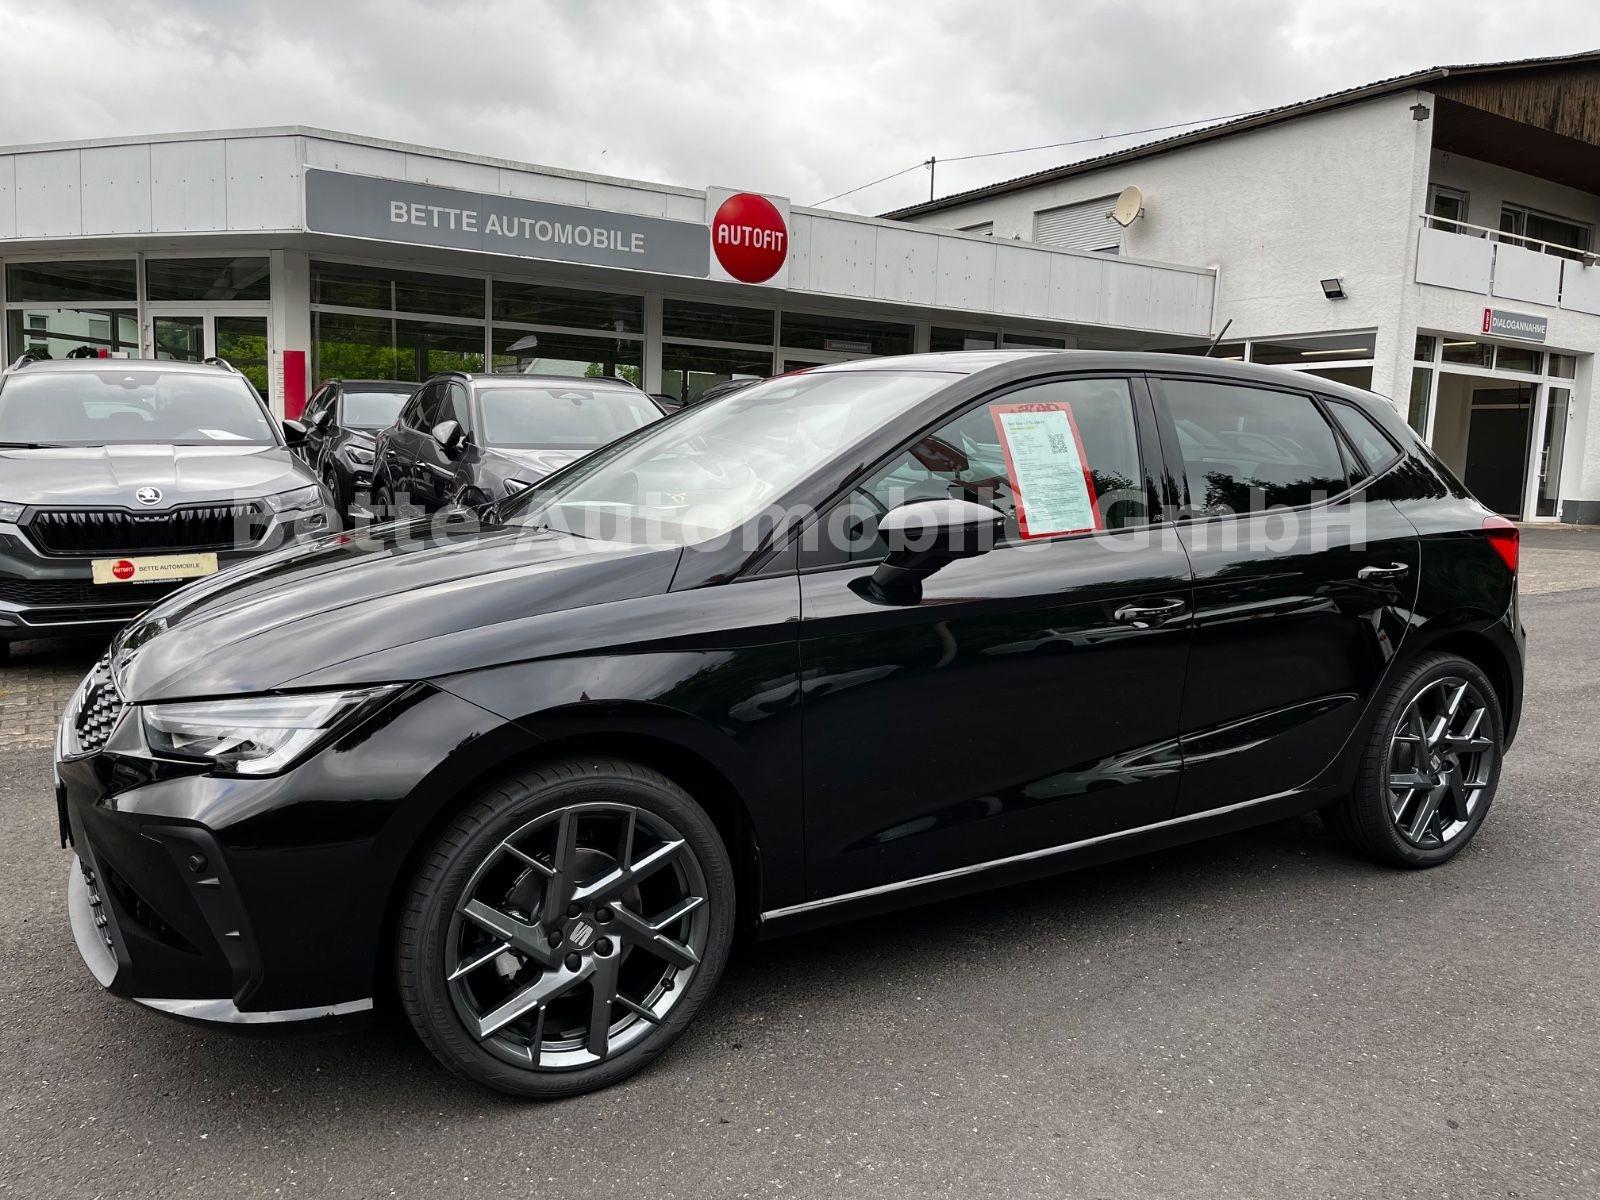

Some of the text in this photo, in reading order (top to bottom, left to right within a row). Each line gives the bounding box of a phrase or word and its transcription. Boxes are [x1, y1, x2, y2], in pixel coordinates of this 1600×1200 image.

[390, 200, 645, 254] BETTE AUTOMOBILE
[718, 223, 784, 252] AUTOFIT
[1492, 317, 1545, 333] DIALOGANNAHME
